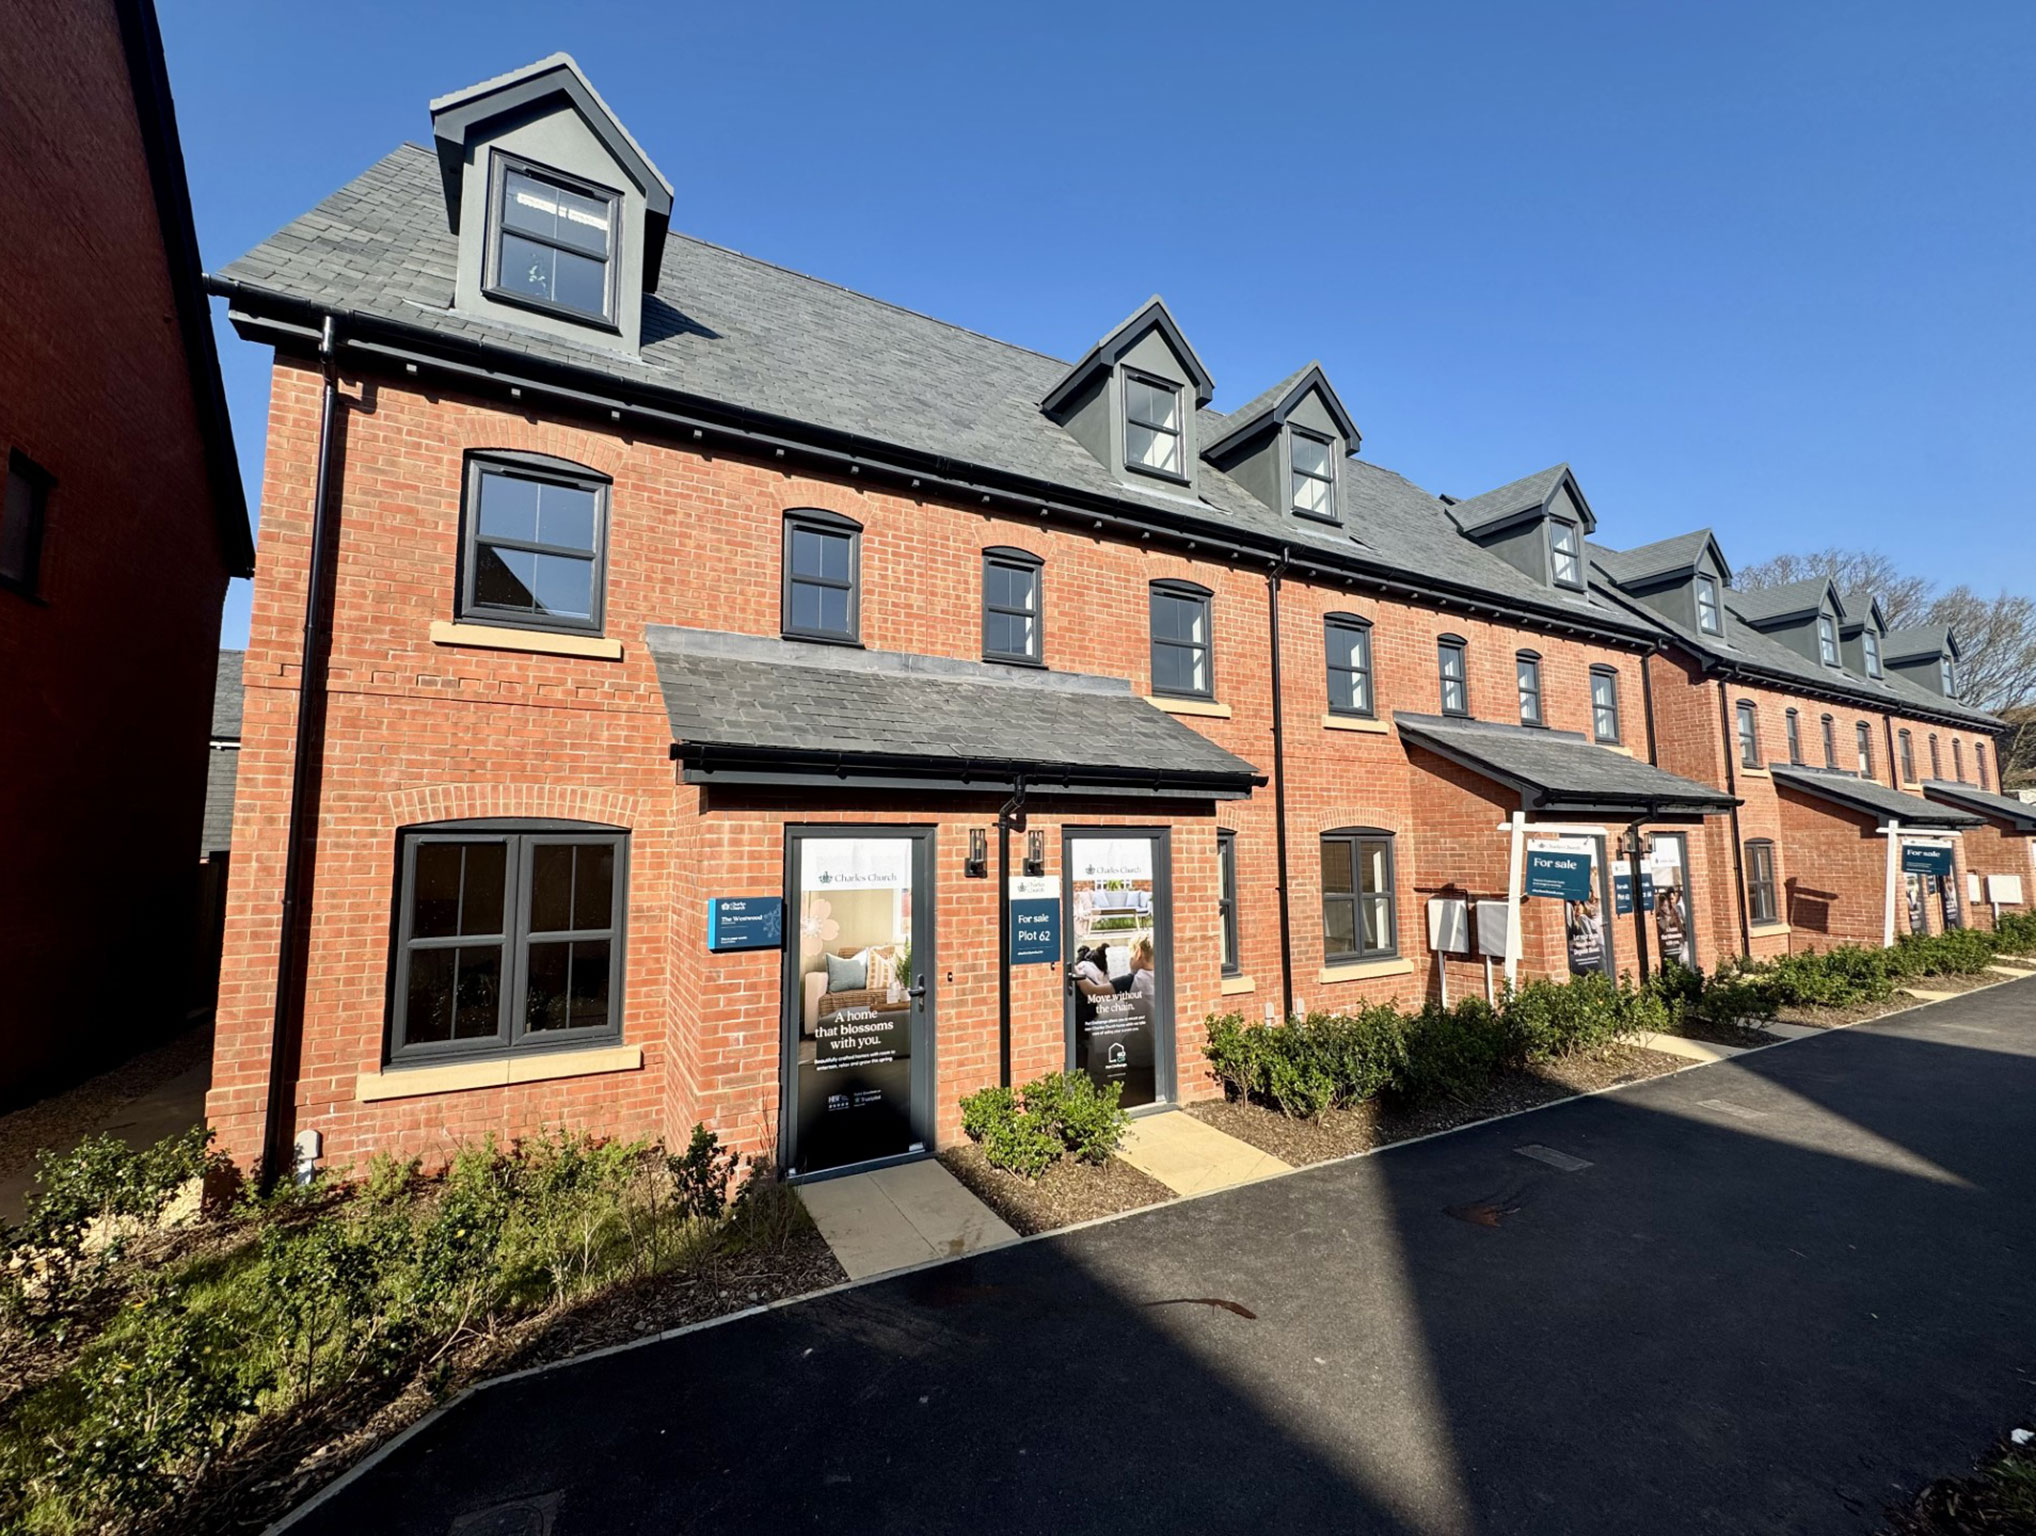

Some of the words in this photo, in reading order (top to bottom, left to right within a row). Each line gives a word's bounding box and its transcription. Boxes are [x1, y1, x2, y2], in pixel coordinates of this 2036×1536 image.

[1534, 857, 1553, 867] For
[1555, 860, 1577, 869] sale
[834, 873, 866, 882] Charles
[868, 873, 897, 882] Church
[1018, 915, 1032, 924] For
[1033, 913, 1049, 922] sale
[1018, 930, 1038, 941] Plot
[1039, 930, 1051, 941] 62
[1087, 993, 1111, 1004] Move
[1112, 991, 1142, 1001] without
[1096, 1004, 1110, 1013] the
[1111, 1002, 1135, 1012] chain.
[835, 1011, 844, 1022] A
[847, 1010, 878, 1021] home
[815, 1027, 838, 1038] that
[840, 1021, 894, 1035] blossoms
[831, 1037, 856, 1049] with
[857, 1036, 881, 1049] you.
